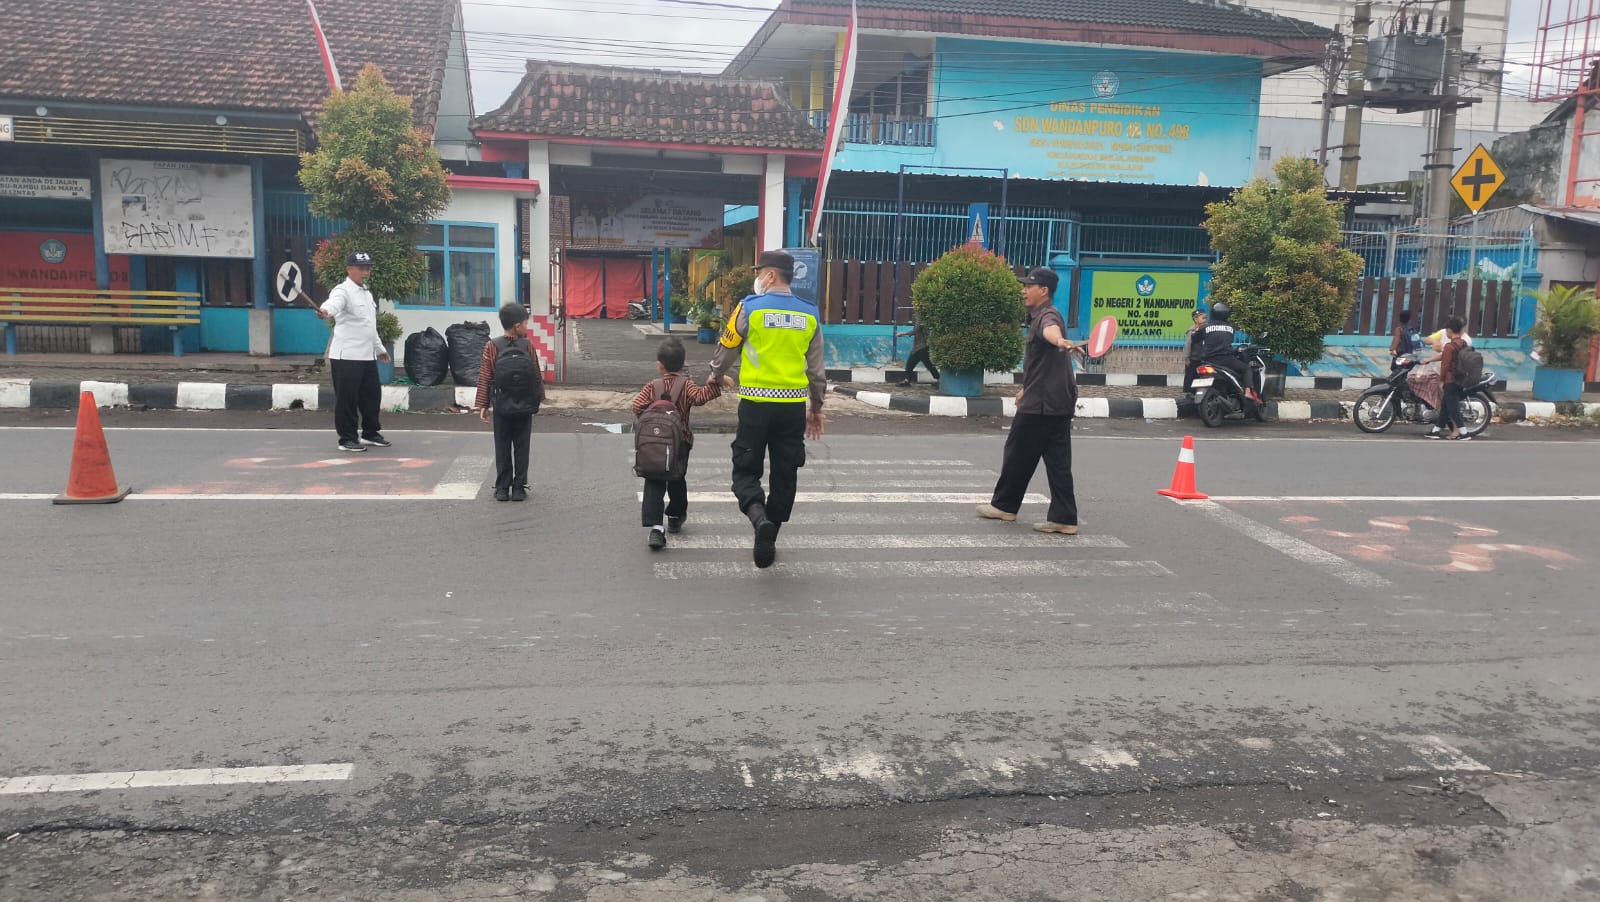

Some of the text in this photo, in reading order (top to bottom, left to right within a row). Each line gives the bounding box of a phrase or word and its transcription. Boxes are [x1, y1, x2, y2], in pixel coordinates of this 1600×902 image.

[1050, 101, 1161, 116] DINAS PENDIDIKAN
[1015, 117, 1038, 133] SDN
[1042, 118, 1122, 137] WANDANPURO
[1094, 298, 1195, 309] SD NEGERI 2 WANDANPURO
[1127, 310, 1159, 318] NO. 498
[764, 313, 807, 329] POLISI
[1122, 328, 1161, 336] MALANG
